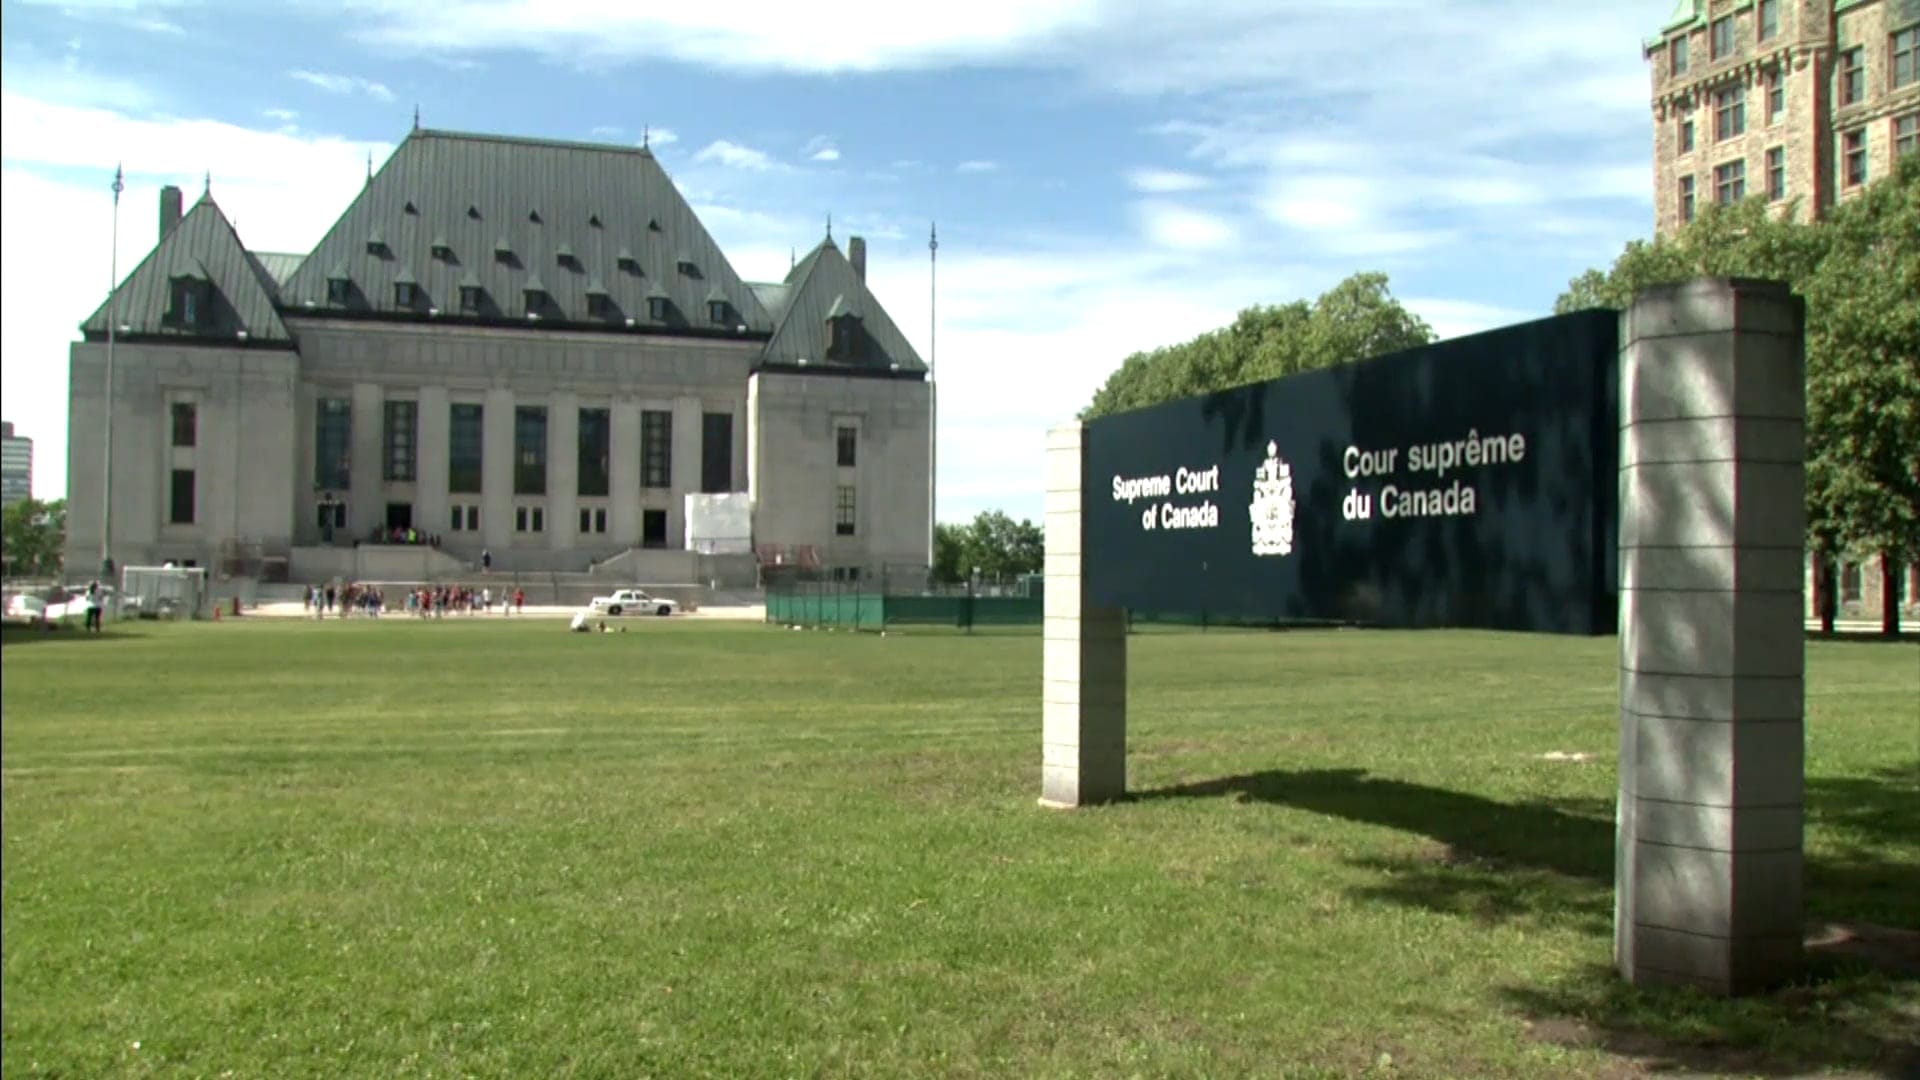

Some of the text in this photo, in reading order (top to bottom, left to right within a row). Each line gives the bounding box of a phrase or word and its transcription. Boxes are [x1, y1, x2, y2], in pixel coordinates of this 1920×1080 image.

[1343, 428, 1525, 479] Cour suprême
[1112, 464, 1219, 505] Supreme Court
[1342, 482, 1476, 521] du Canada
[1142, 500, 1219, 531] of Canada
